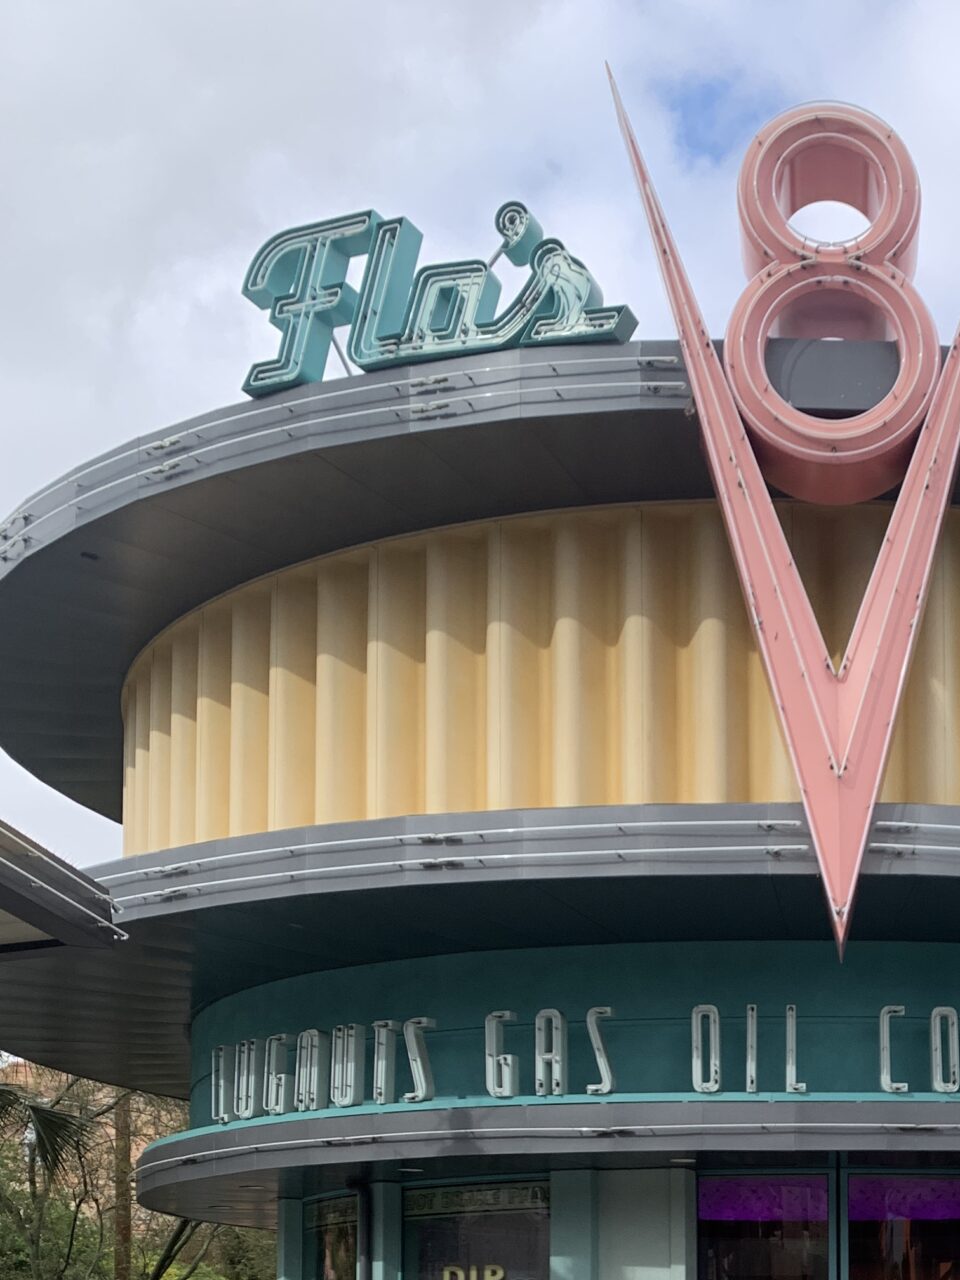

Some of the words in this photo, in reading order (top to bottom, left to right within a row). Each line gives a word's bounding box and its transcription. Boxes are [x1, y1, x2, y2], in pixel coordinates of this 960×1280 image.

[241, 200, 640, 400] Flo's
[211, 1016, 436, 1124] LUGNUTS
[485, 1006, 616, 1097] GAS
[690, 1003, 806, 1093] OIL
